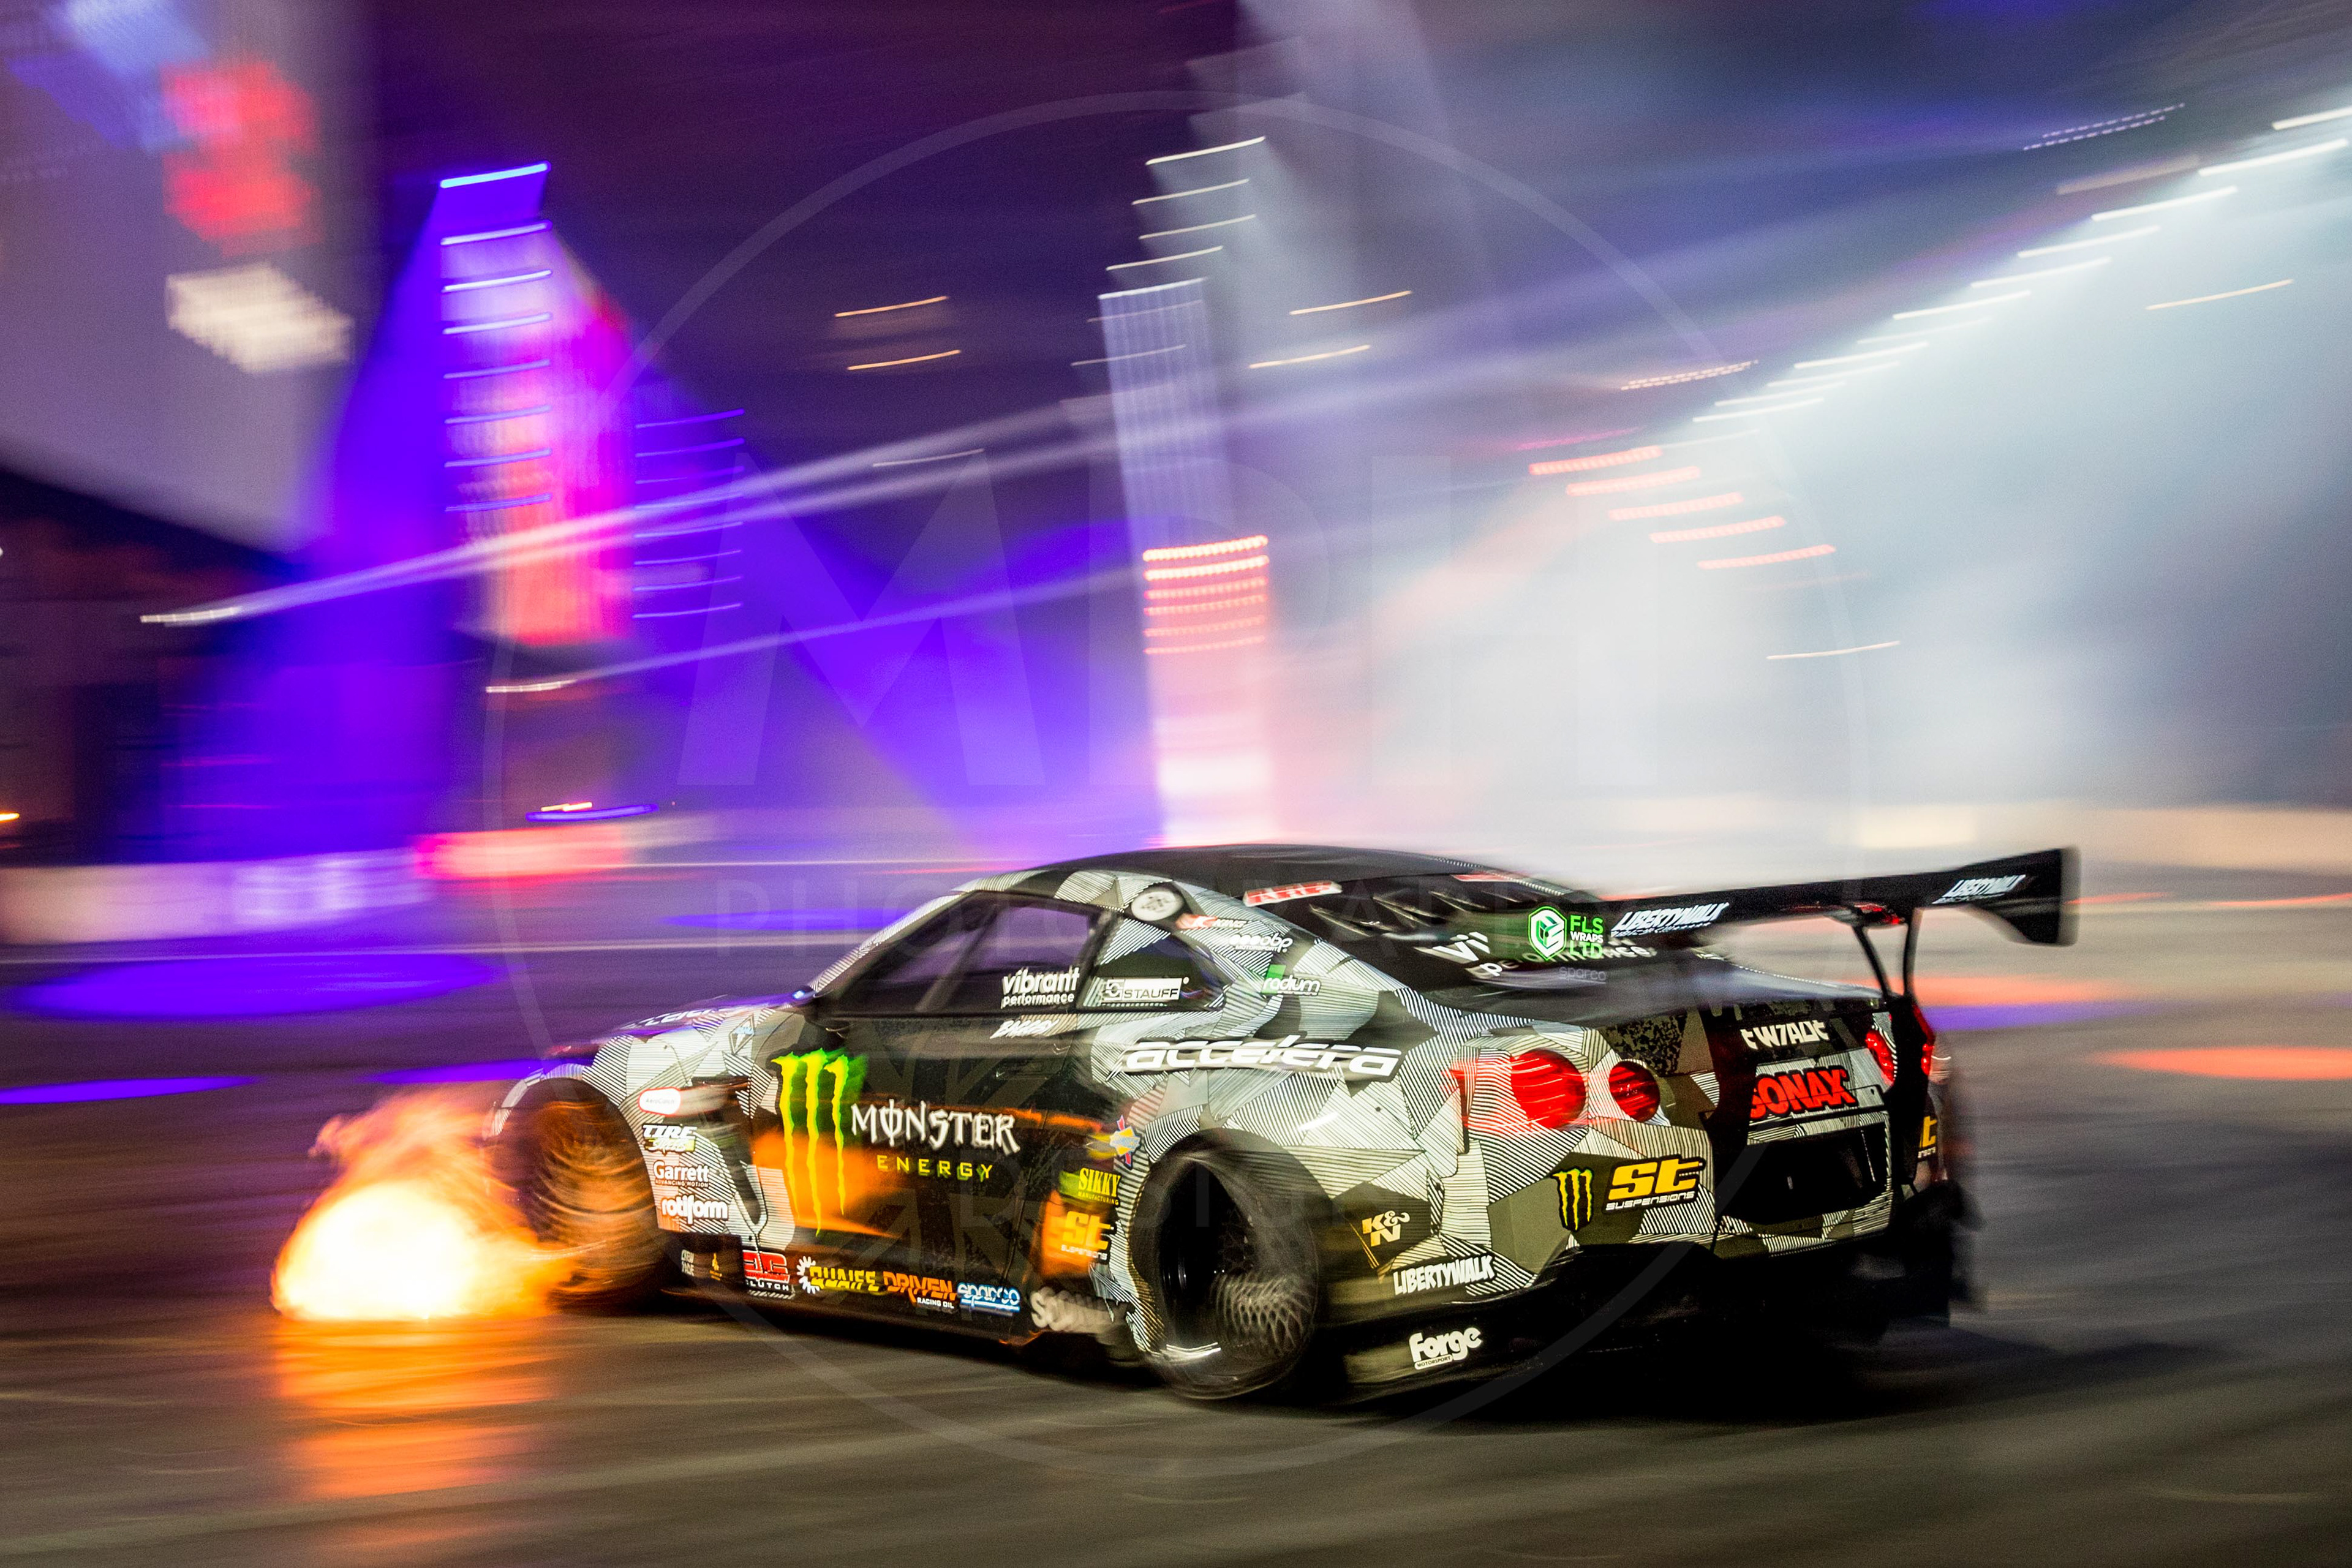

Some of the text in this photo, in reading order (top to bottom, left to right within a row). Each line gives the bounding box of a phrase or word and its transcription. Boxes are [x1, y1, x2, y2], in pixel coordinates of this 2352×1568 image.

[1570, 915, 1604, 934] FLS
[1570, 931, 1604, 944] WRAPS
[1569, 940, 1604, 959] LTD
[1002, 967, 1080, 995] vibrant
[1001, 992, 1075, 1009] performance
[1124, 988, 1179, 999] STAUFF
[1126, 1035, 1402, 1076] accelera
[851, 1099, 1021, 1156] MONSTER
[653, 1161, 709, 1182] Garrett
[876, 1155, 993, 1180] ENERGY
[655, 1178, 685, 1187] ADVANCING
[1079, 1167, 1121, 1197] SIKKY
[1077, 1191, 1120, 1205] MANUFACTURING
[1605, 1191, 1695, 1211] SUSPENSIONS
[1393, 1255, 1496, 1296] LIBERTYWALK
[883, 1270, 958, 1303] DRIVEN
[957, 1282, 1020, 1310] sparco
[917, 1297, 954, 1309] RACING OIL
[1417, 1355, 1451, 1367] MOTORSPORT
